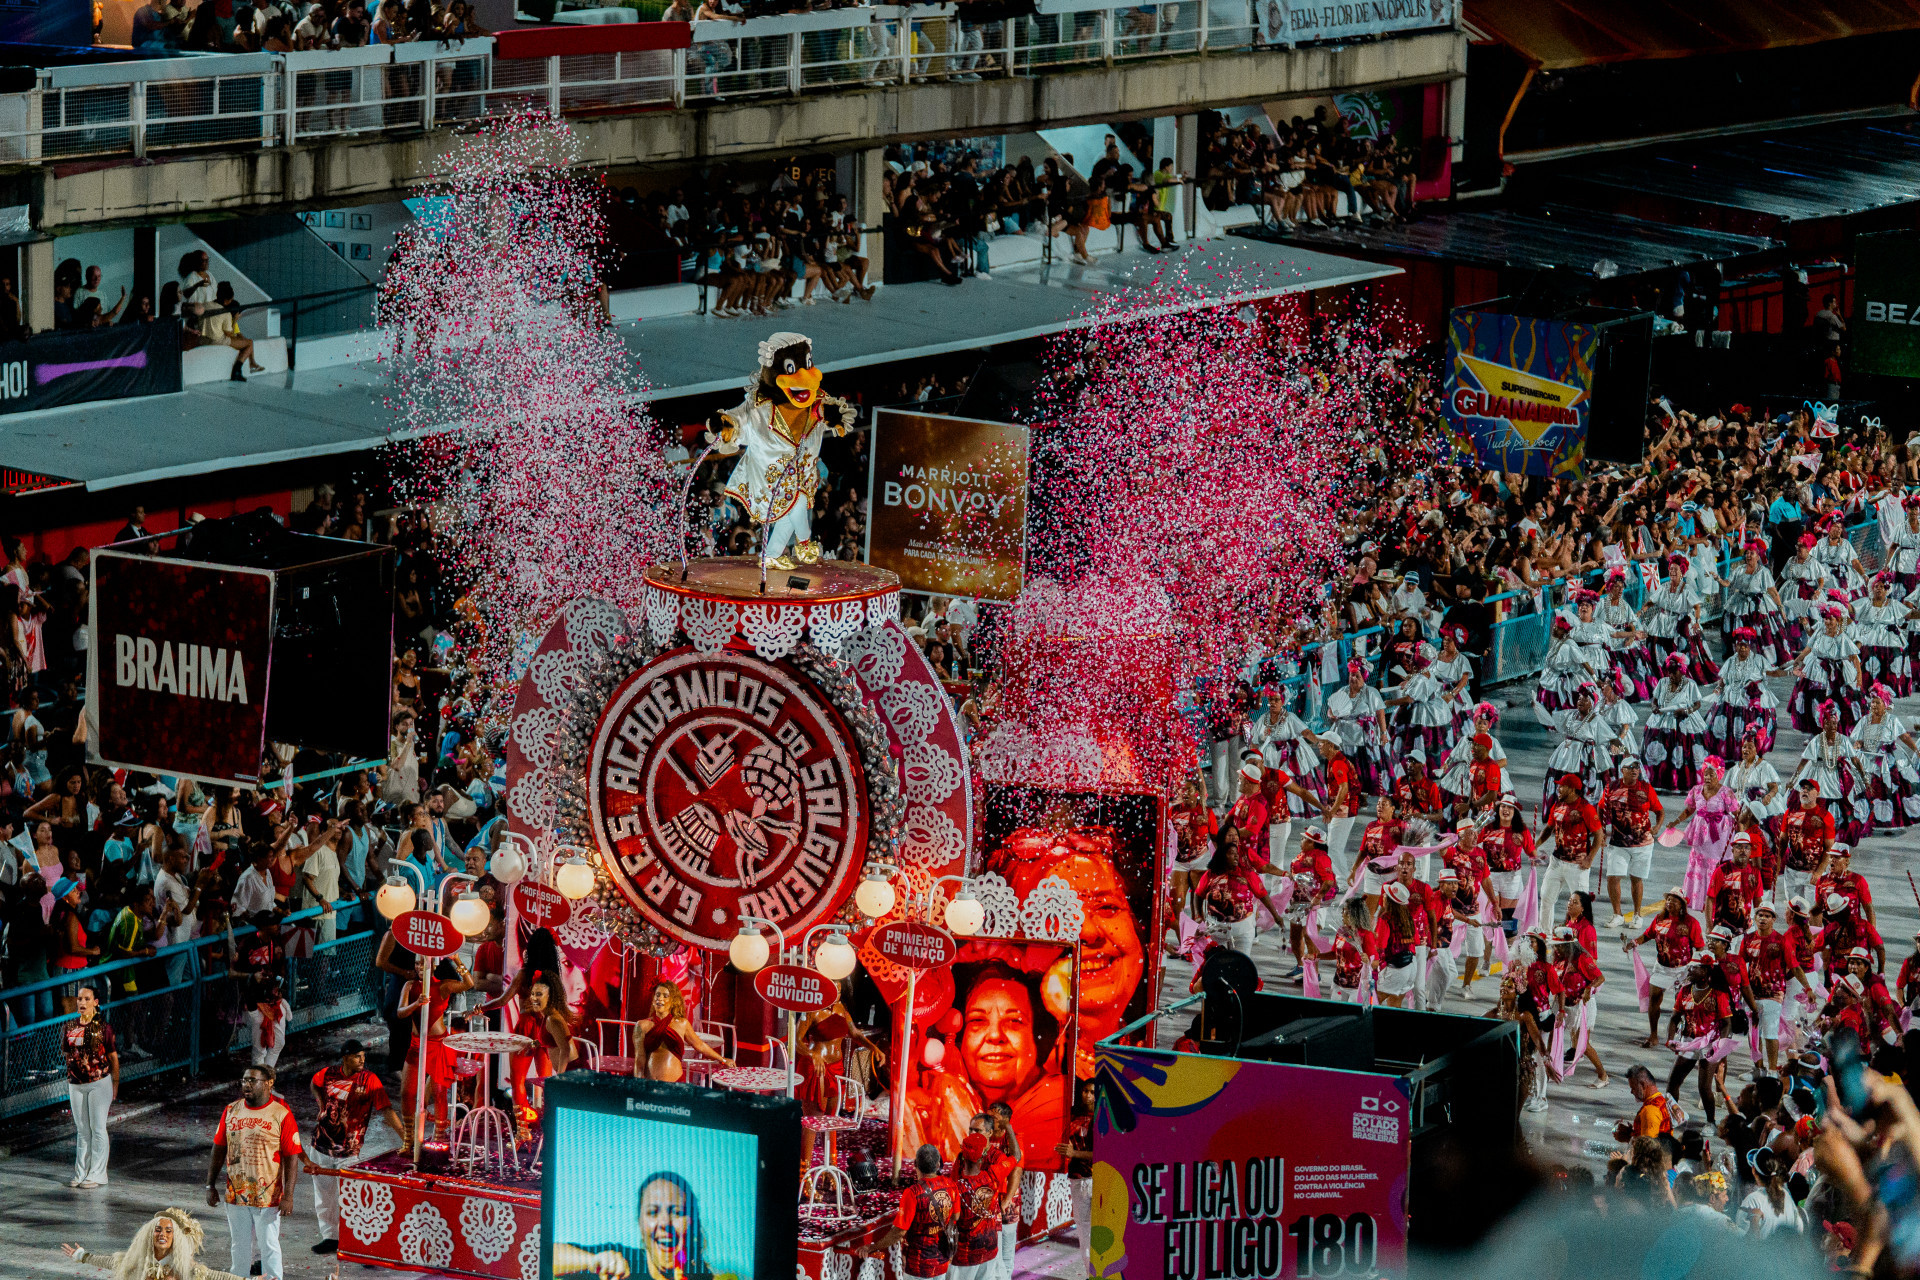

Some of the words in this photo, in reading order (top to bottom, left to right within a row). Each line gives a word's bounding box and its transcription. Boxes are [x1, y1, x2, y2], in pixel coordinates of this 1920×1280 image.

[1355, 2, 1369, 23] DE
[1501, 381, 1560, 402] SUPERMERCADOS
[1454, 388, 1579, 426] GUANABARA
[1483, 428, 1512, 450] Tudo
[1510, 439, 1529, 454] por
[902, 464, 991, 487] MARRIOTT
[884, 481, 1007, 519] BONVOY
[903, 548, 919, 557] PARA
[920, 550, 935, 559] CADA
[116, 633, 248, 704] BRAHMA
[606, 669, 786, 794] ACADÊMICOS
[775, 719, 812, 760] DO
[738, 758, 843, 932] SALGUEIRO
[526, 899, 552, 919] LACÉ
[410, 917, 443, 935] SILVA
[407, 931, 445, 950] TELES
[886, 930, 944, 949] PRIMEIRO
[883, 941, 898, 954] DE
[902, 945, 945, 964] MARÇO
[771, 972, 796, 988] RUA
[801, 977, 820, 991] DO
[767, 984, 823, 1005] OUVIDOR
[635, 1101, 691, 1116] eletromidia
[1353, 1116, 1369, 1126] DO
[1371, 1118, 1399, 1130] LADO
[1353, 1131, 1398, 1144] BRASILEIRAS
[1132, 1162, 1168, 1224] SE
[1173, 1159, 1240, 1222] LIGA
[1244, 1155, 1284, 1219] OU
[1328, 1181, 1365, 1189] VIOLÊNCIA
[1164, 1221, 1200, 1280] EU
[1205, 1217, 1283, 1280] LIGO
[1289, 1212, 1378, 1278] 180
